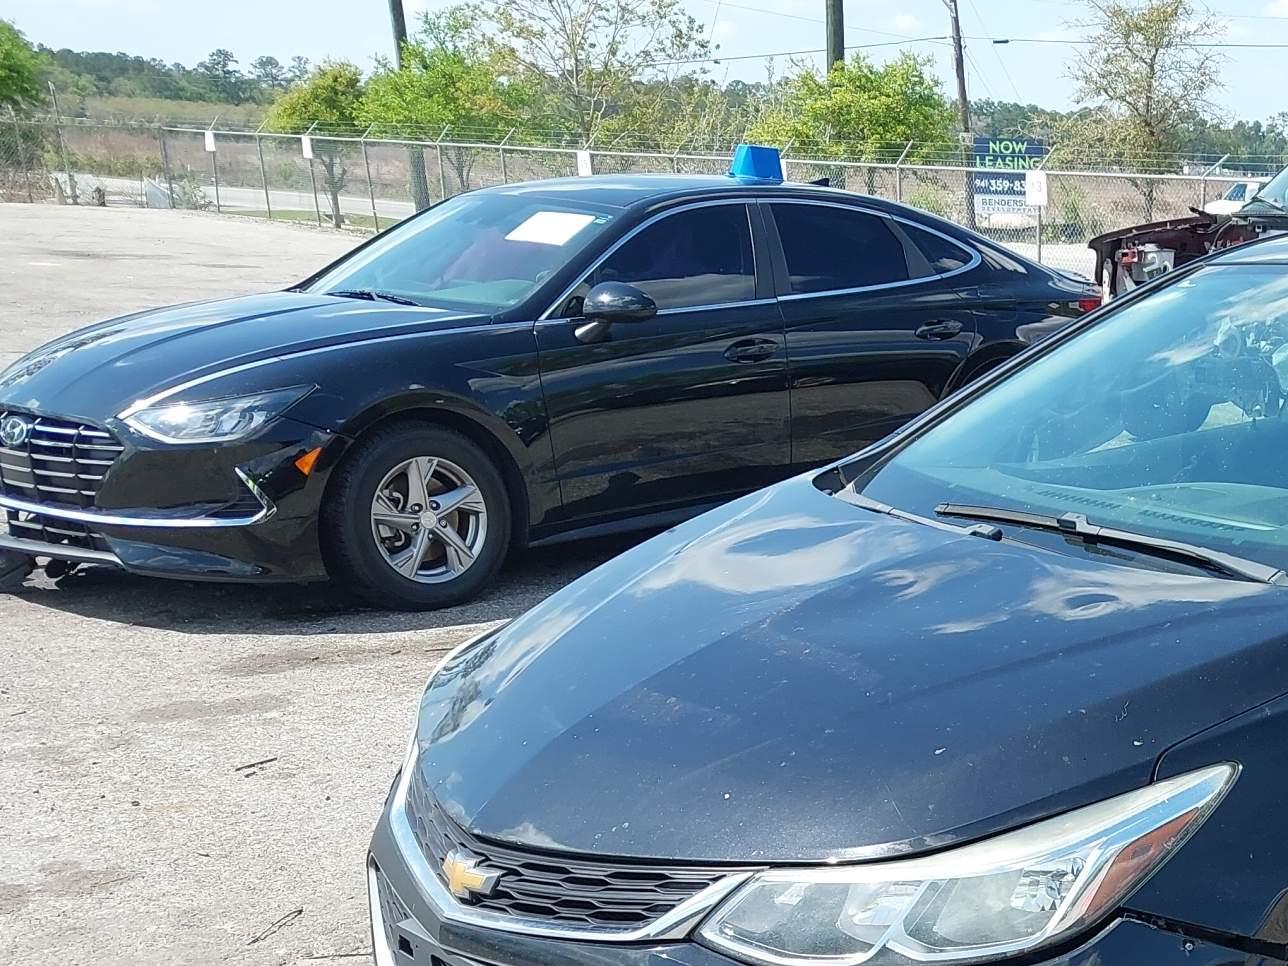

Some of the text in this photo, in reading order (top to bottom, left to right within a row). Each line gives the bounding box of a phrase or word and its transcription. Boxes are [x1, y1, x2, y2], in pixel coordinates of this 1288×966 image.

[989, 141, 1028, 154] NOW
[976, 156, 1041, 169] LEASING
[989, 178, 1026, 191] 359-83
